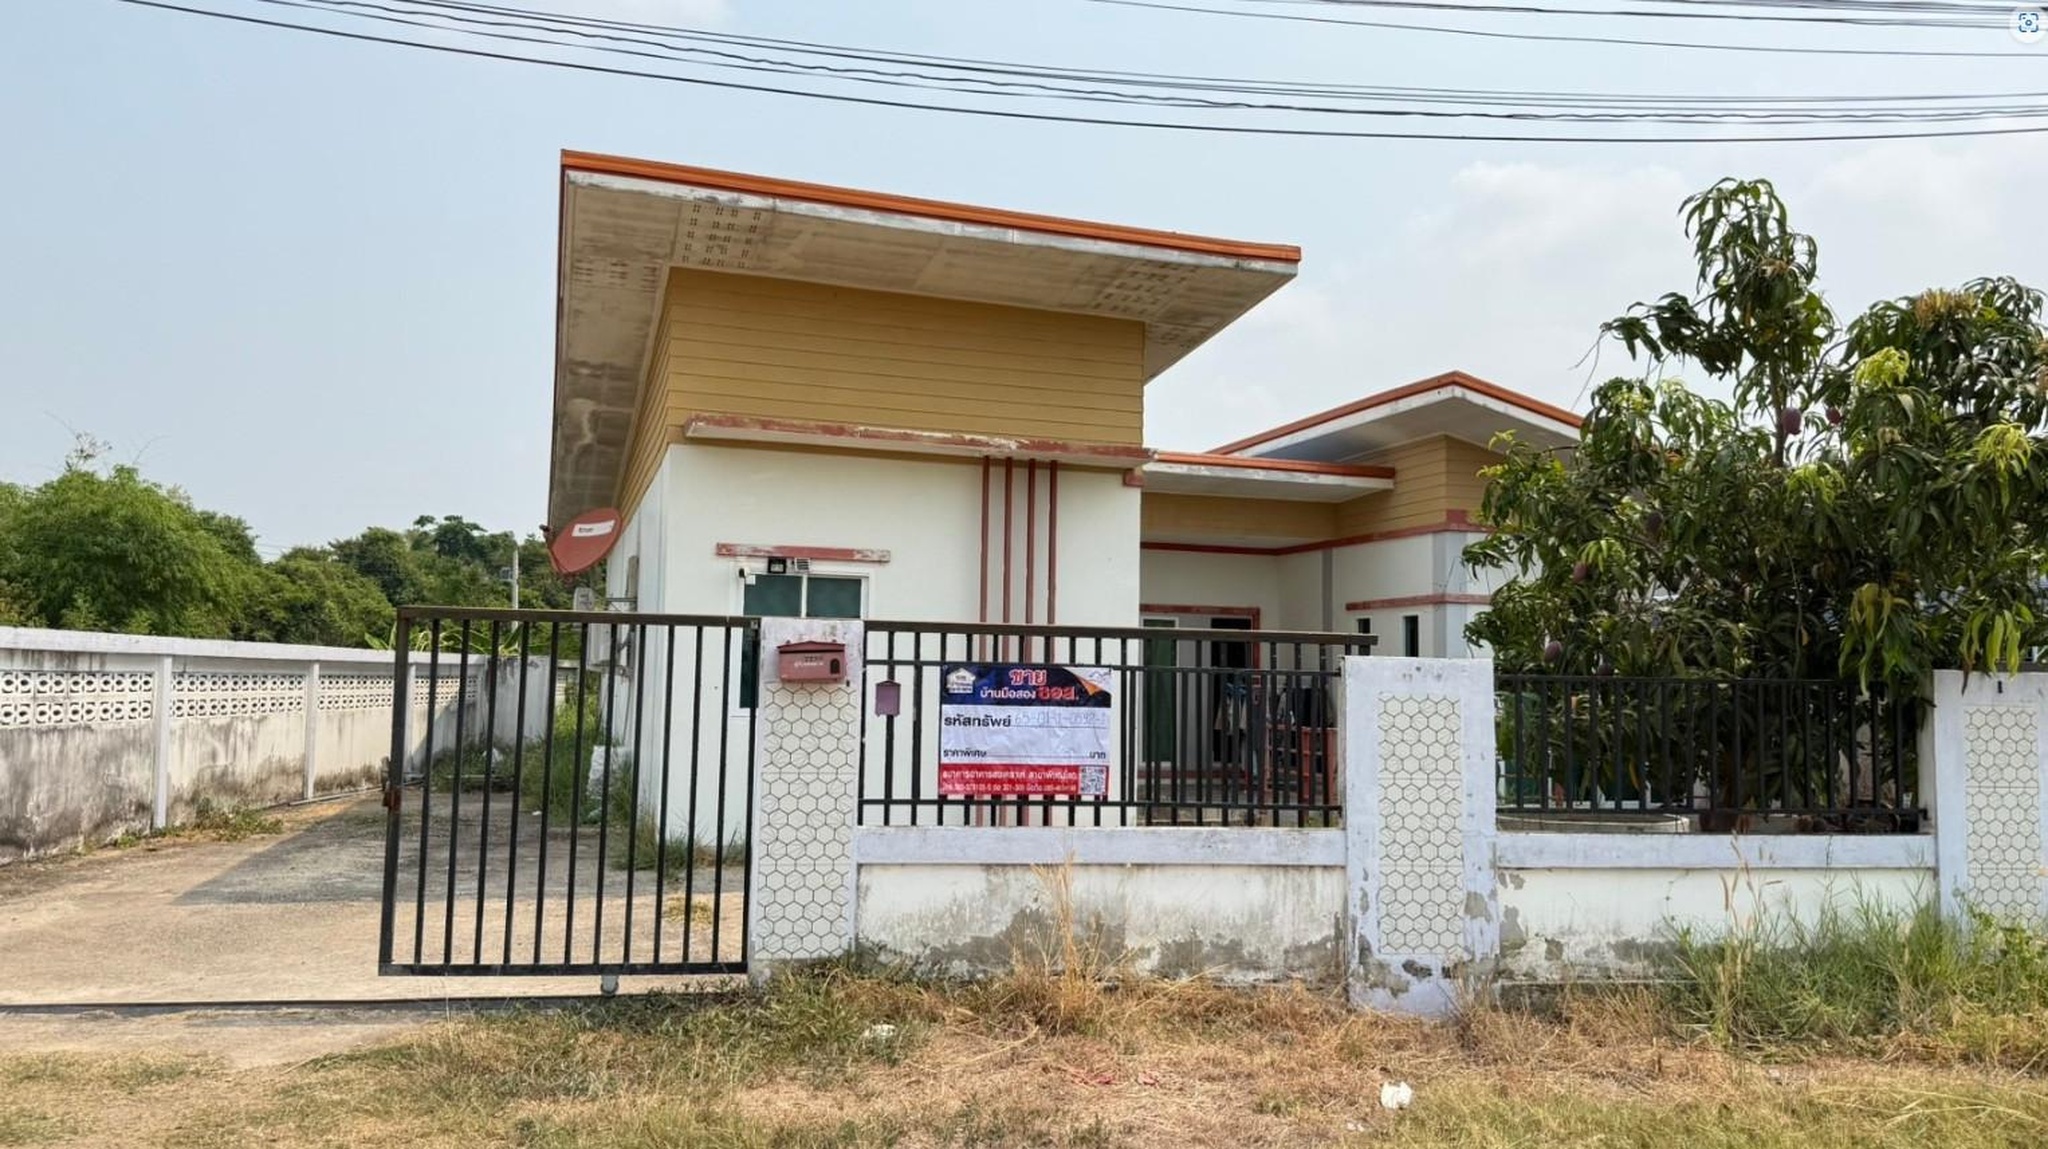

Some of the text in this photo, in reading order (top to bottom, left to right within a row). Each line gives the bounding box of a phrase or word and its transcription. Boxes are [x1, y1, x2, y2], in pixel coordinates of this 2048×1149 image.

[1009, 669, 1048, 686] ขาย
[980, 685, 1036, 700] บ้านมือสอง
[943, 713, 1012, 728] รหัสทรัพย์
[943, 748, 1107, 760] ราคาพิเศษ บาท
